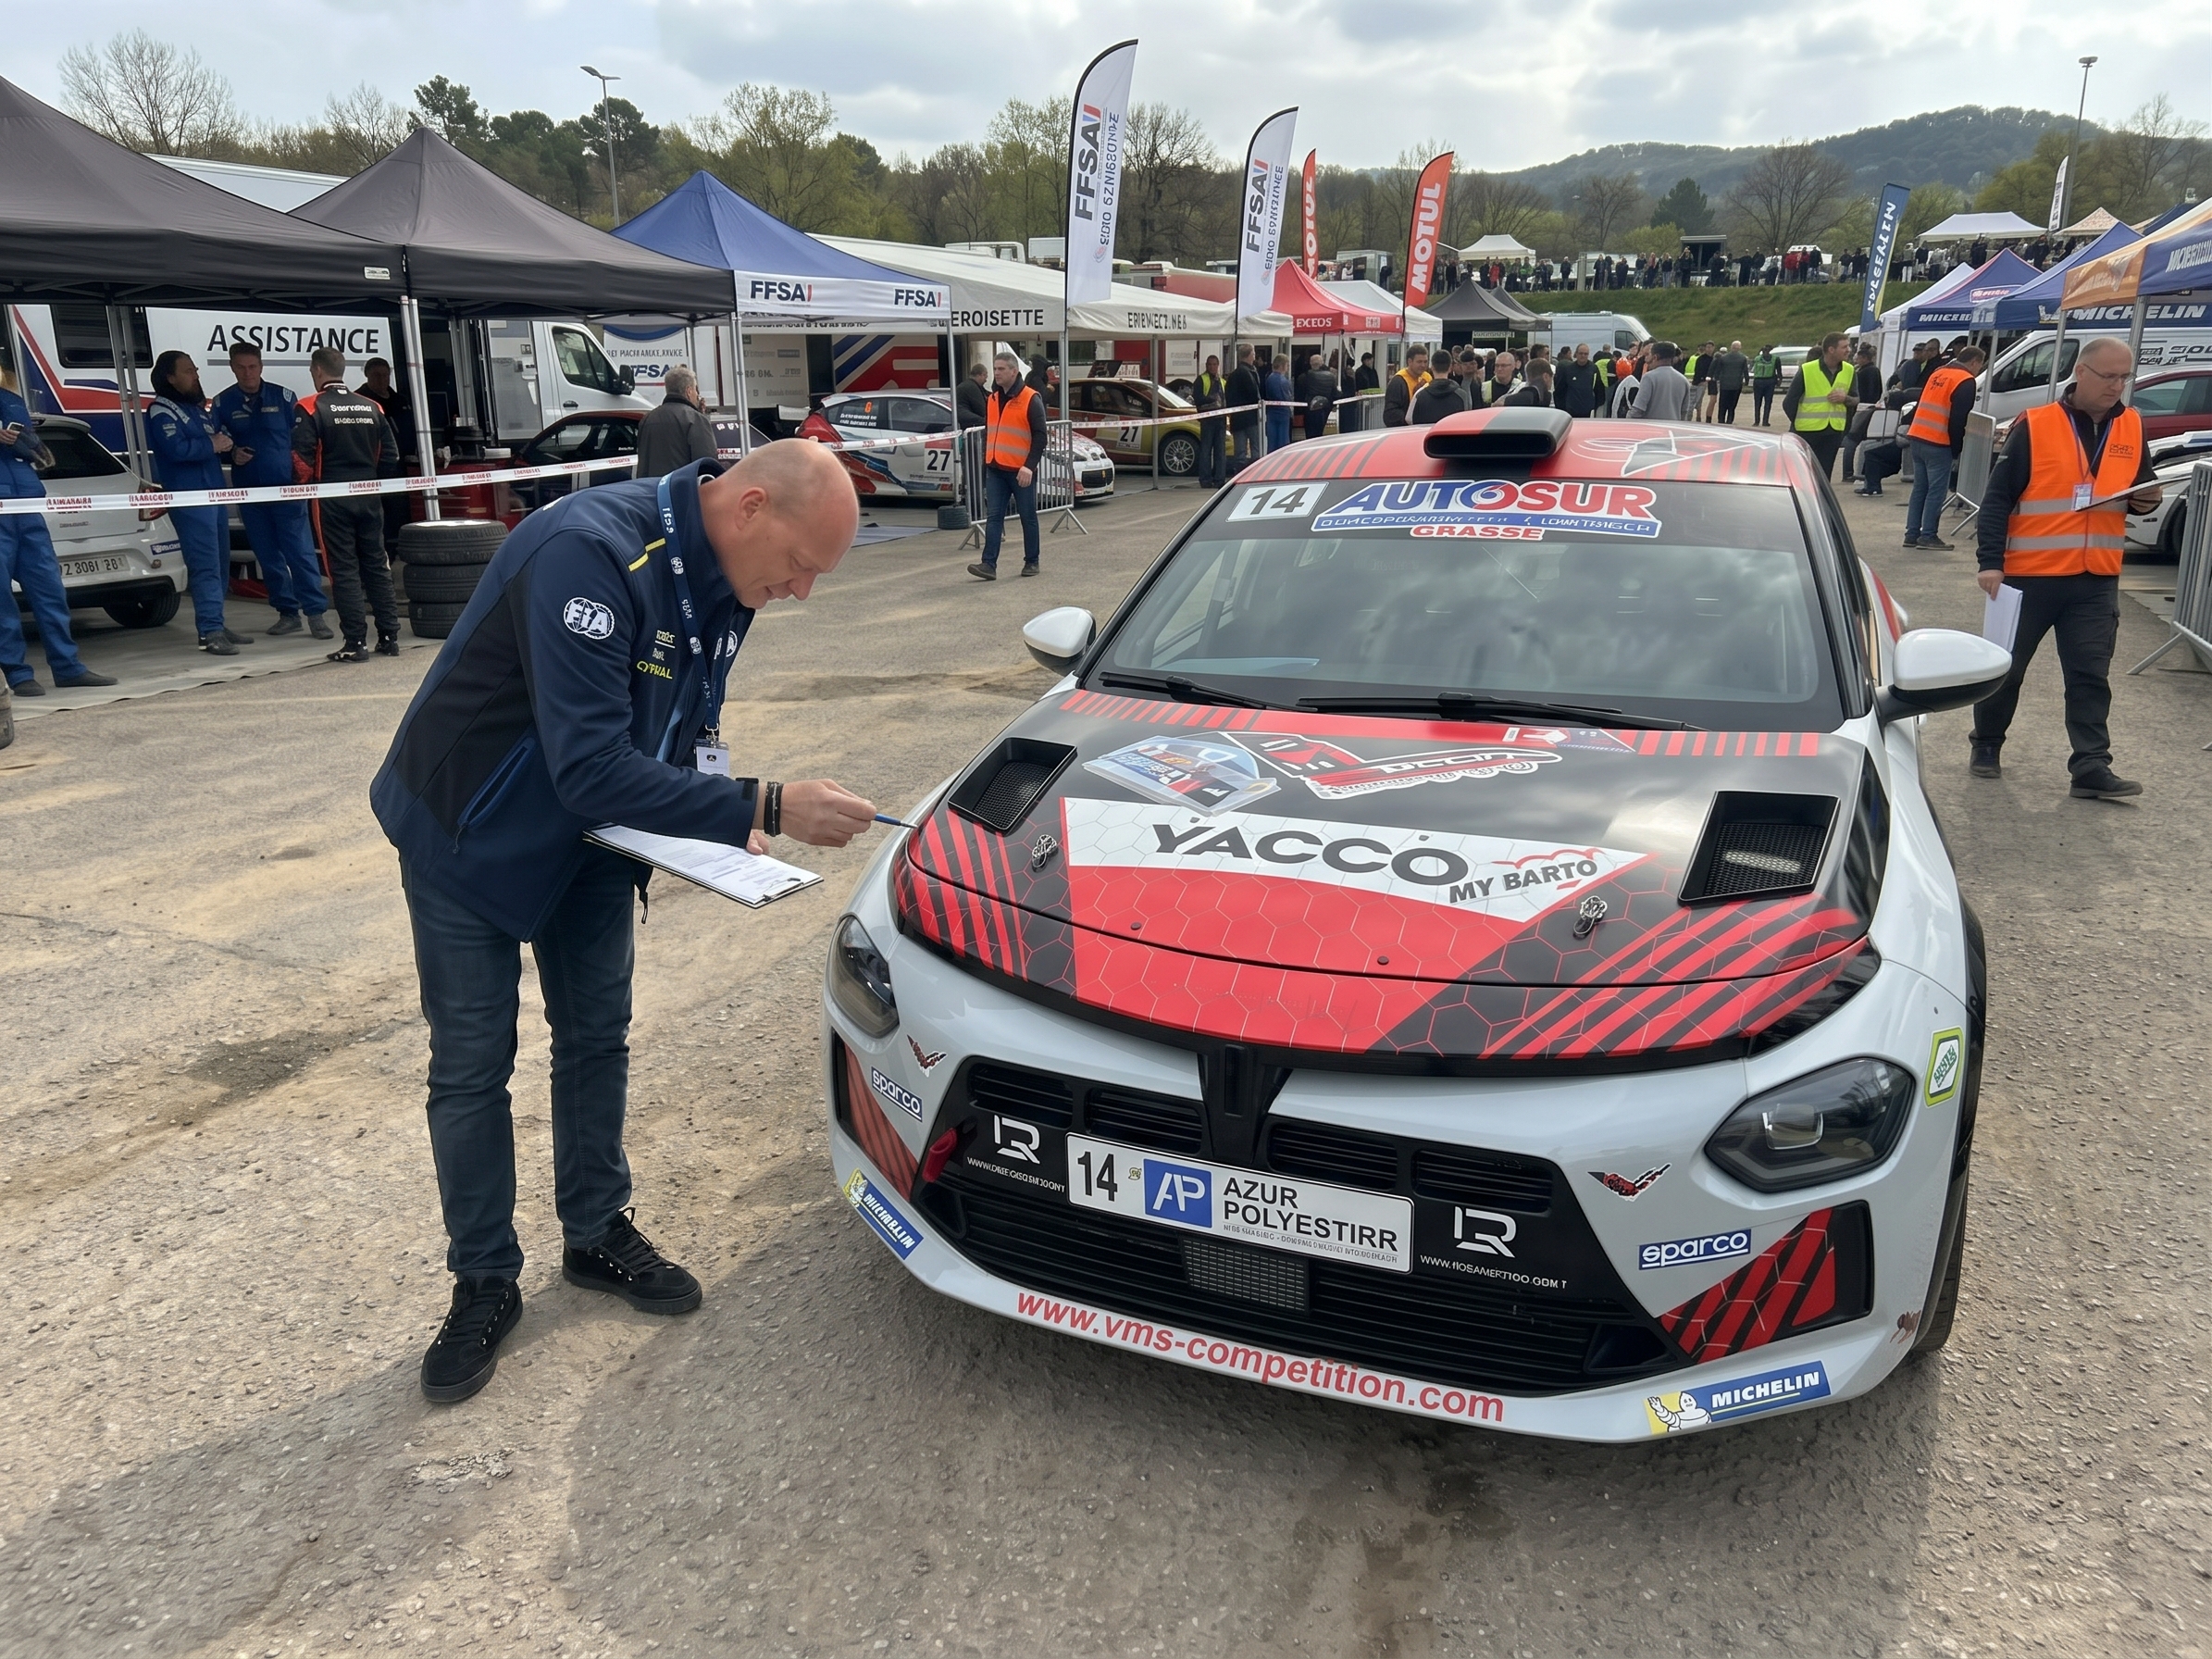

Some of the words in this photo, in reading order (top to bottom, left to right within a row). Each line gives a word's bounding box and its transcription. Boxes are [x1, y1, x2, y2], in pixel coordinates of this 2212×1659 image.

[1075, 120, 1100, 221] FFSA
[1246, 173, 1268, 253] FFSA
[1410, 182, 1441, 293] MOTUL
[751, 281, 806, 302] FFSA
[894, 289, 937, 307] FFSA
[207, 324, 379, 354] ASSISTANCE
[926, 449, 951, 471] 27
[1249, 486, 1314, 517] 14
[1331, 480, 1655, 518] AUTOSUR
[1412, 525, 1543, 539] GRASSE
[1151, 824, 1469, 886] YACCO
[1449, 877, 1495, 904] MY
[1502, 859, 1597, 891] BARTO
[872, 1068, 922, 1116] sparco
[1076, 1151, 1118, 1202] 14
[1223, 1177, 1299, 1209] AZUR
[1224, 1201, 1398, 1253] POLYESTIRR
[1642, 1232, 1748, 1266] sparco
[1017, 1292, 1504, 1423] www.vms-competition.com
[1711, 1372, 1821, 1408] MICHELIN
